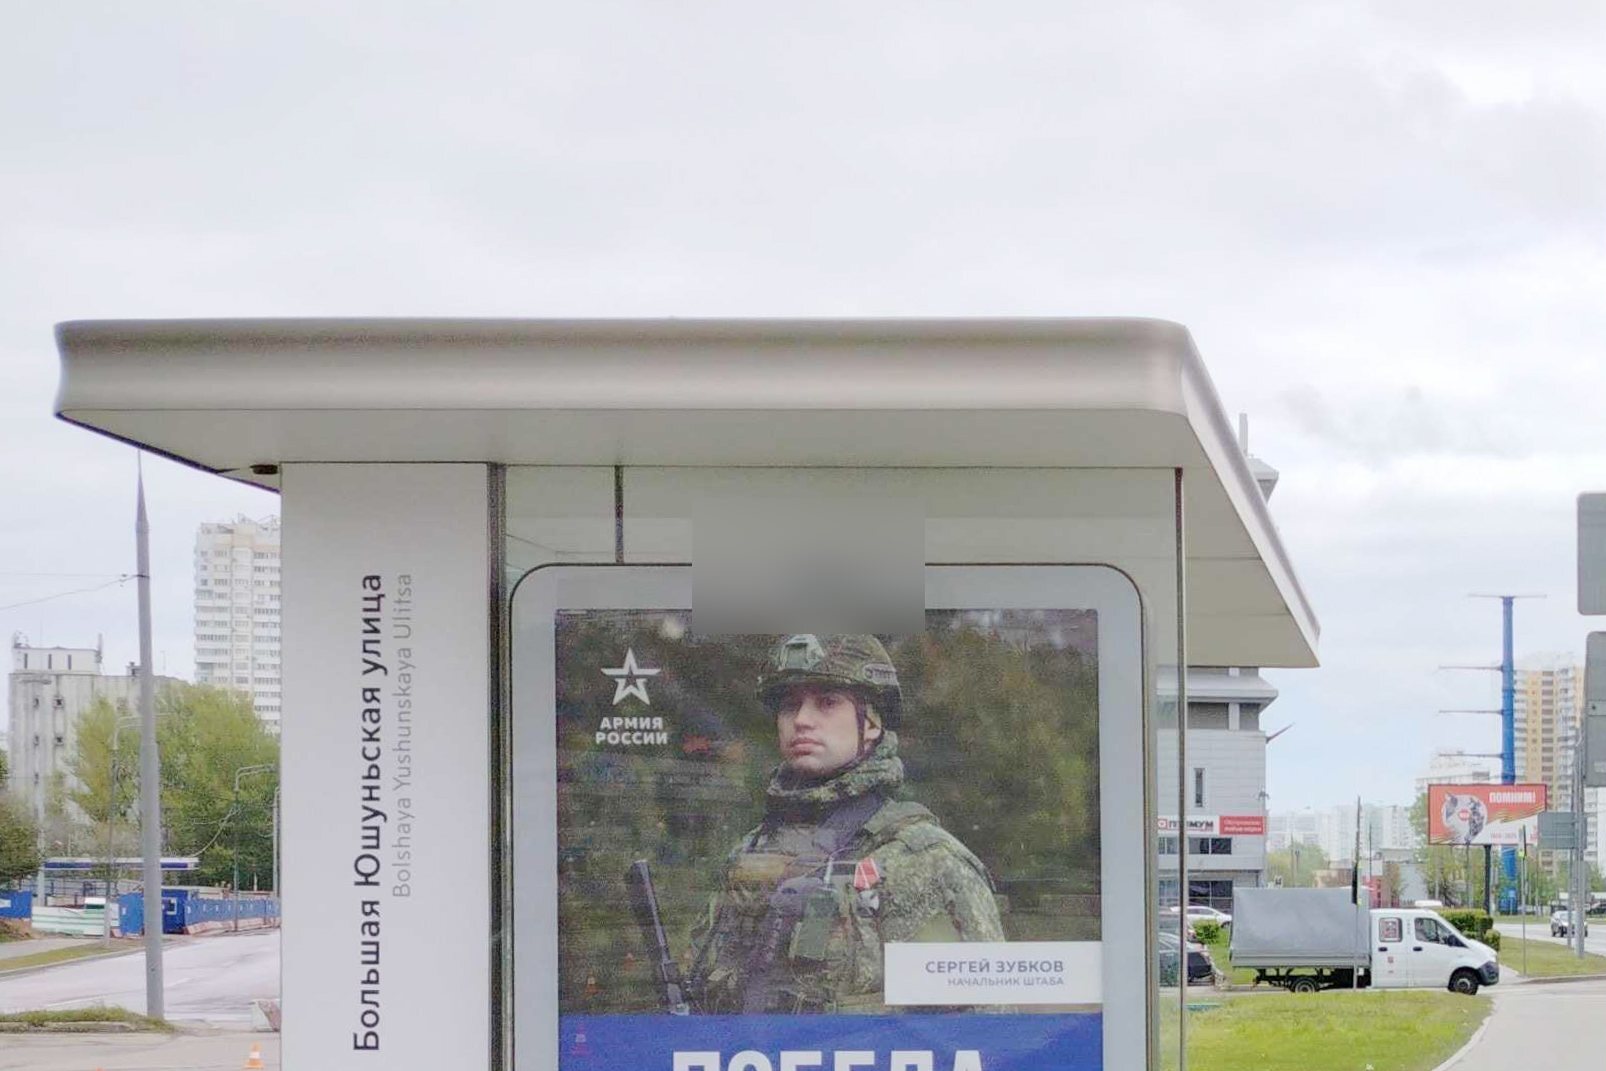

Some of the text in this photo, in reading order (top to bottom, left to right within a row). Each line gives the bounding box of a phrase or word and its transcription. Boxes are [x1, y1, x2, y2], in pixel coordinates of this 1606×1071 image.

[600, 716, 663, 730] АРМИЯ
[391, 573, 415, 899] Bolshaya Yushunskaya Ulitsa
[595, 731, 668, 745] РОССИИ
[353, 573, 388, 1052] Большая Юшуньская улица
[1158, 818, 1214, 830] ОПМУМ
[925, 959, 1064, 973] СЕРГЕЙ ЗУБКОВ
[947, 977, 1064, 986] НАЧАЛЬНИК ШТАБА
